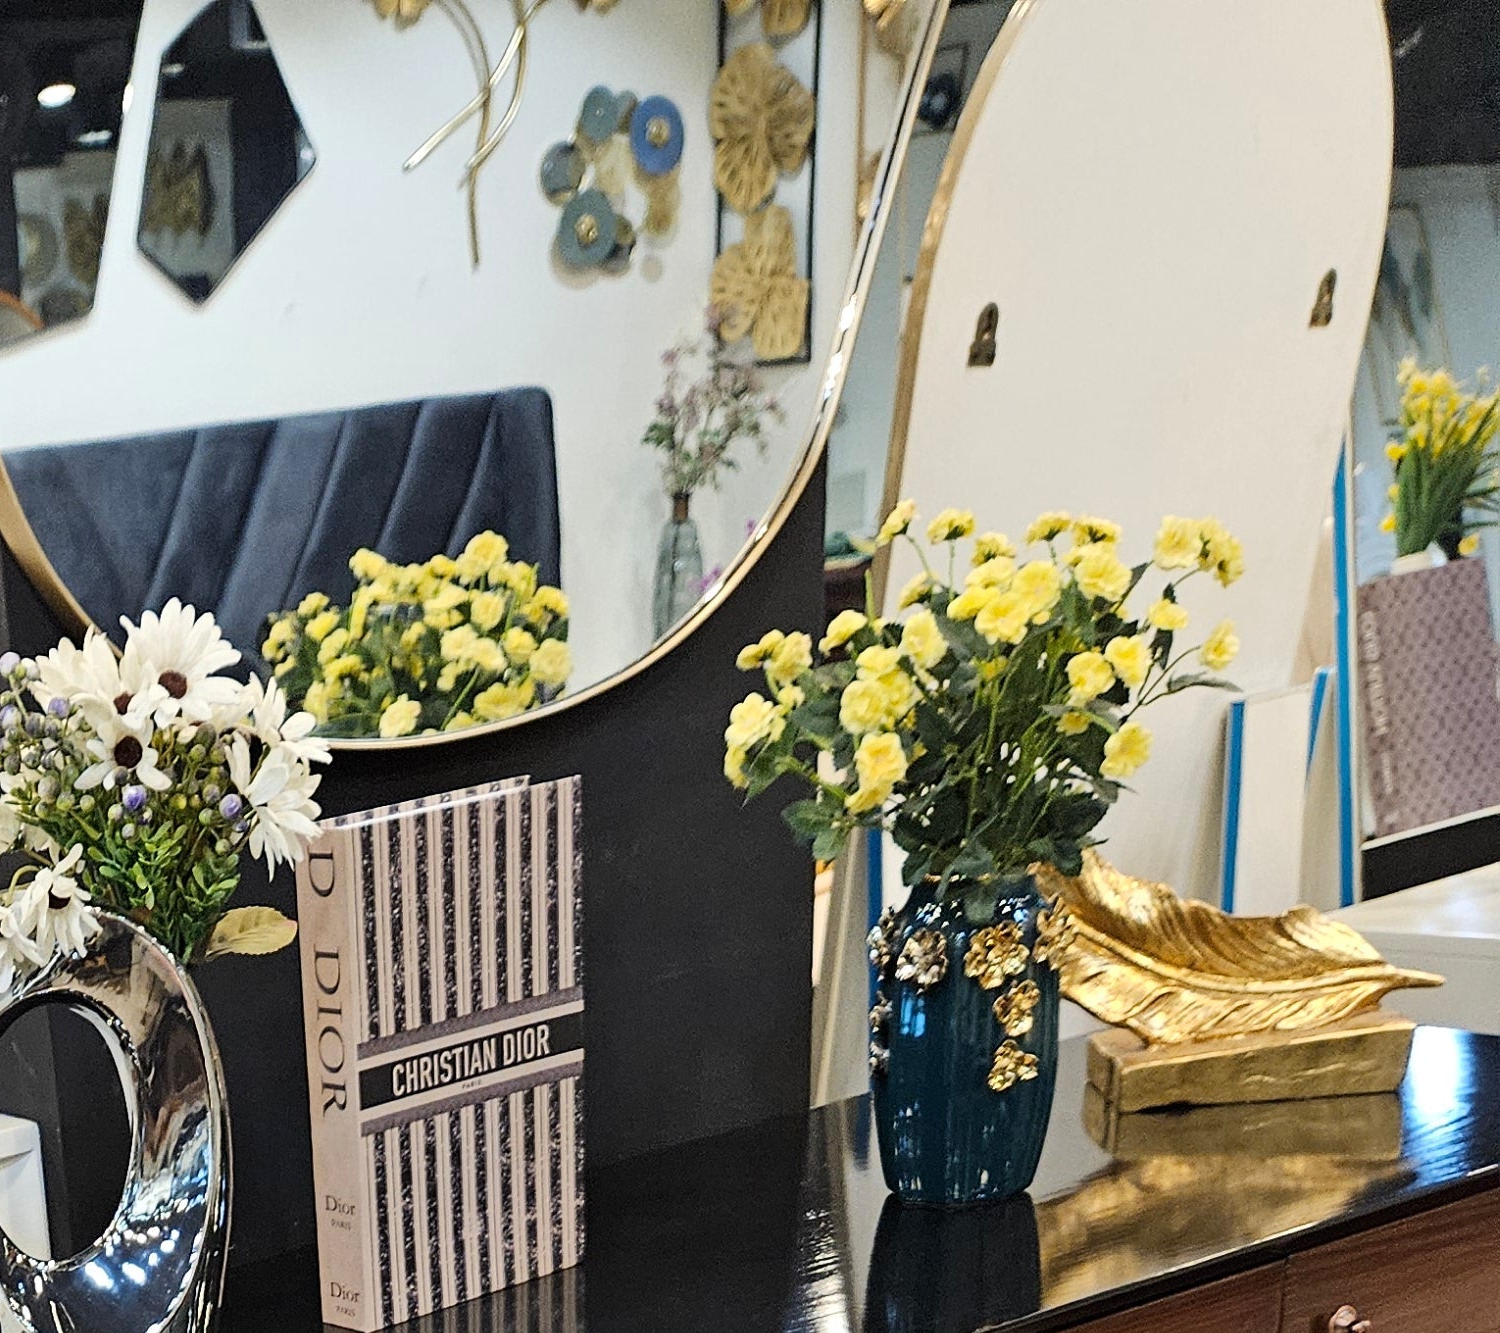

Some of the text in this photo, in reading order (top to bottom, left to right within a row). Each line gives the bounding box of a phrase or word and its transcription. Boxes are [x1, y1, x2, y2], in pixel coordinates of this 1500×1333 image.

[314, 943, 348, 1117] DIOR
[392, 1024, 550, 1097] CHRISTIAN DIOR
[325, 1195, 356, 1216] Dior
[330, 1281, 361, 1303] Dior
